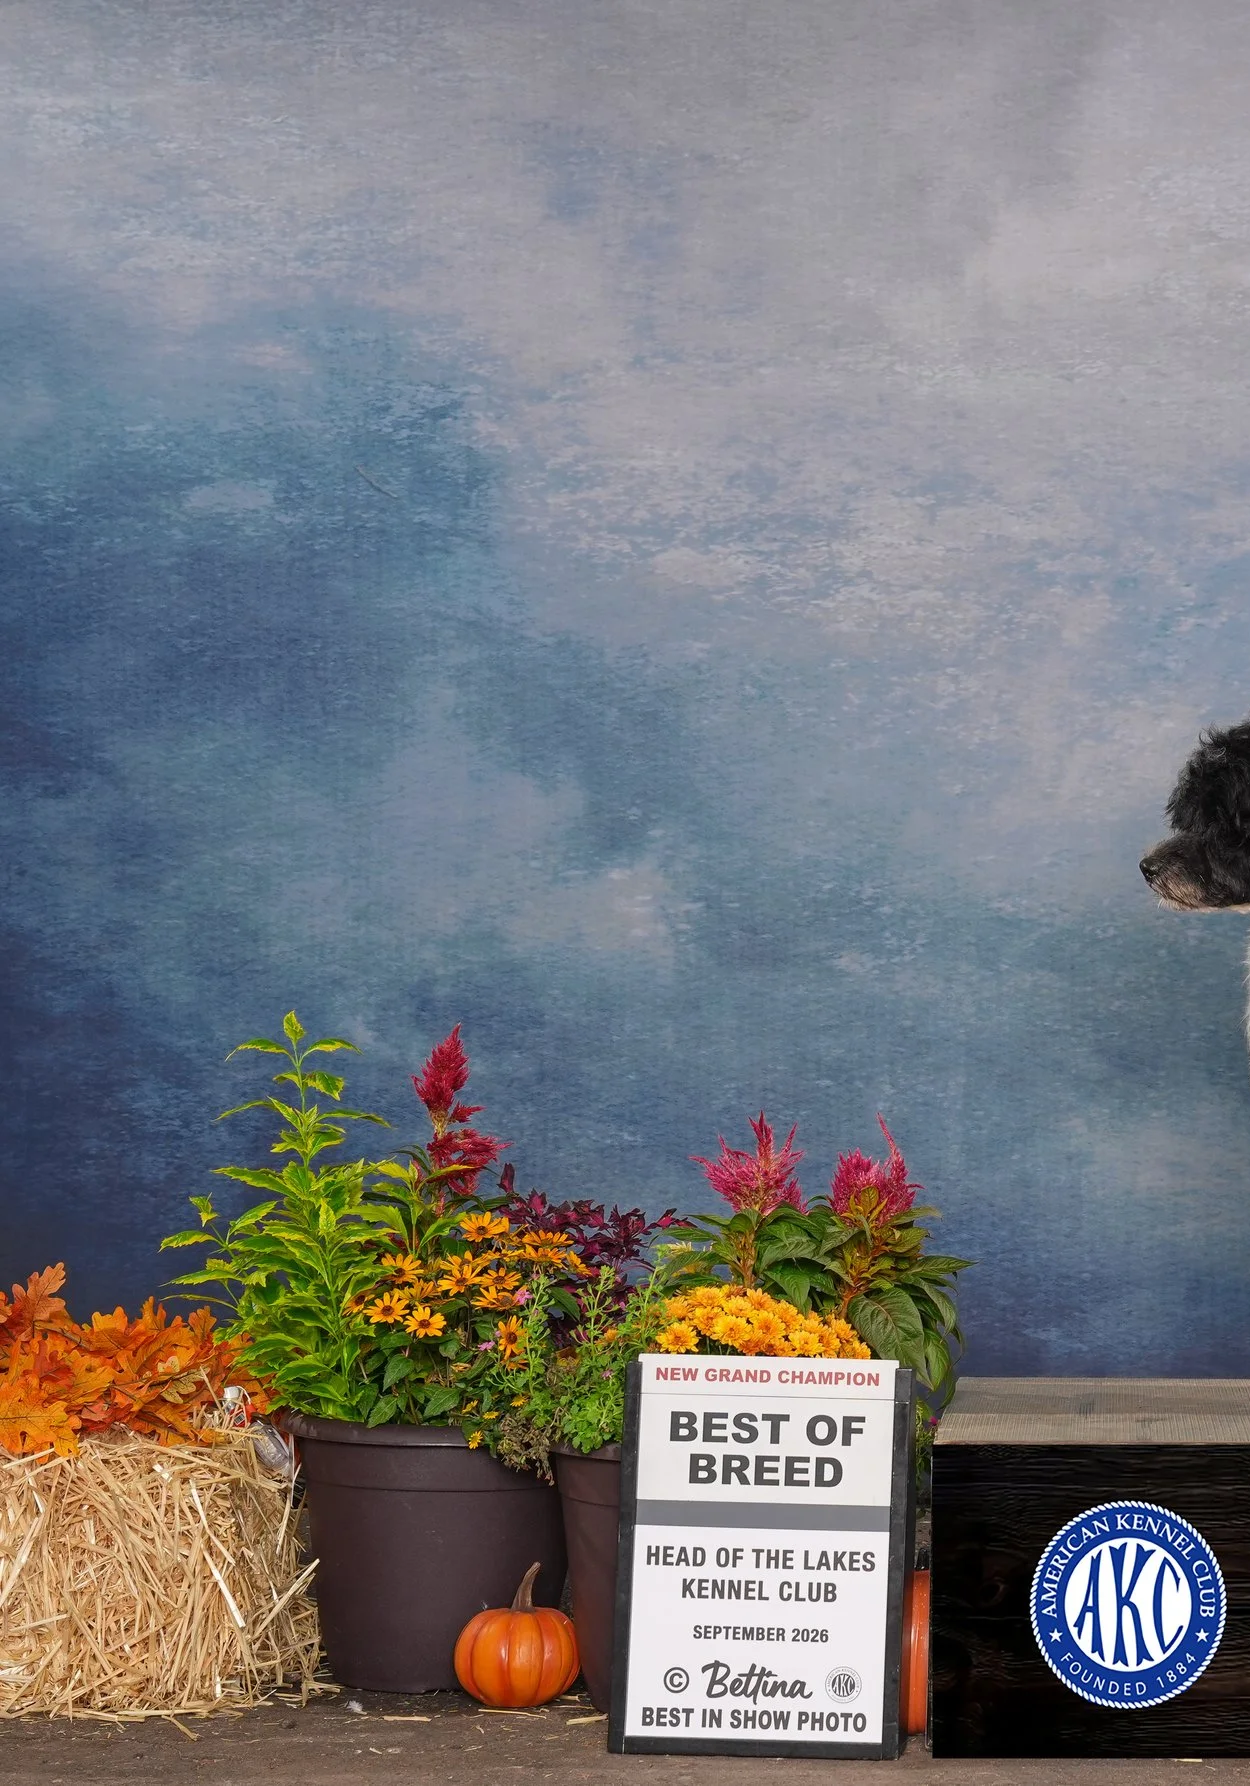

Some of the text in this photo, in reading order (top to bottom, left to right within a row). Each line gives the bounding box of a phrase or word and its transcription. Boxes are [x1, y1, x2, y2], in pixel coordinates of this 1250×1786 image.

[656, 1367, 880, 1386] NEW GRAND CHAMPION
[670, 1410, 866, 1446] BEST OF
[688, 1453, 843, 1488] BREED
[646, 1545, 876, 1572] HEAD OF THE LAKES
[1040, 1513, 1216, 1618] AMERICAN KENNEL CLUB
[682, 1578, 837, 1603] KENNEL CLUB
[1073, 1542, 1184, 1667] AKC
[693, 1624, 829, 1643] SEPTEMBER 2026
[701, 1660, 813, 1705] Bettina
[833, 1674, 854, 1696] AKC
[1060, 1652, 1196, 1696] FOUNDED 1884
[641, 1706, 867, 1732] BEST IN SHOW PHOTO
